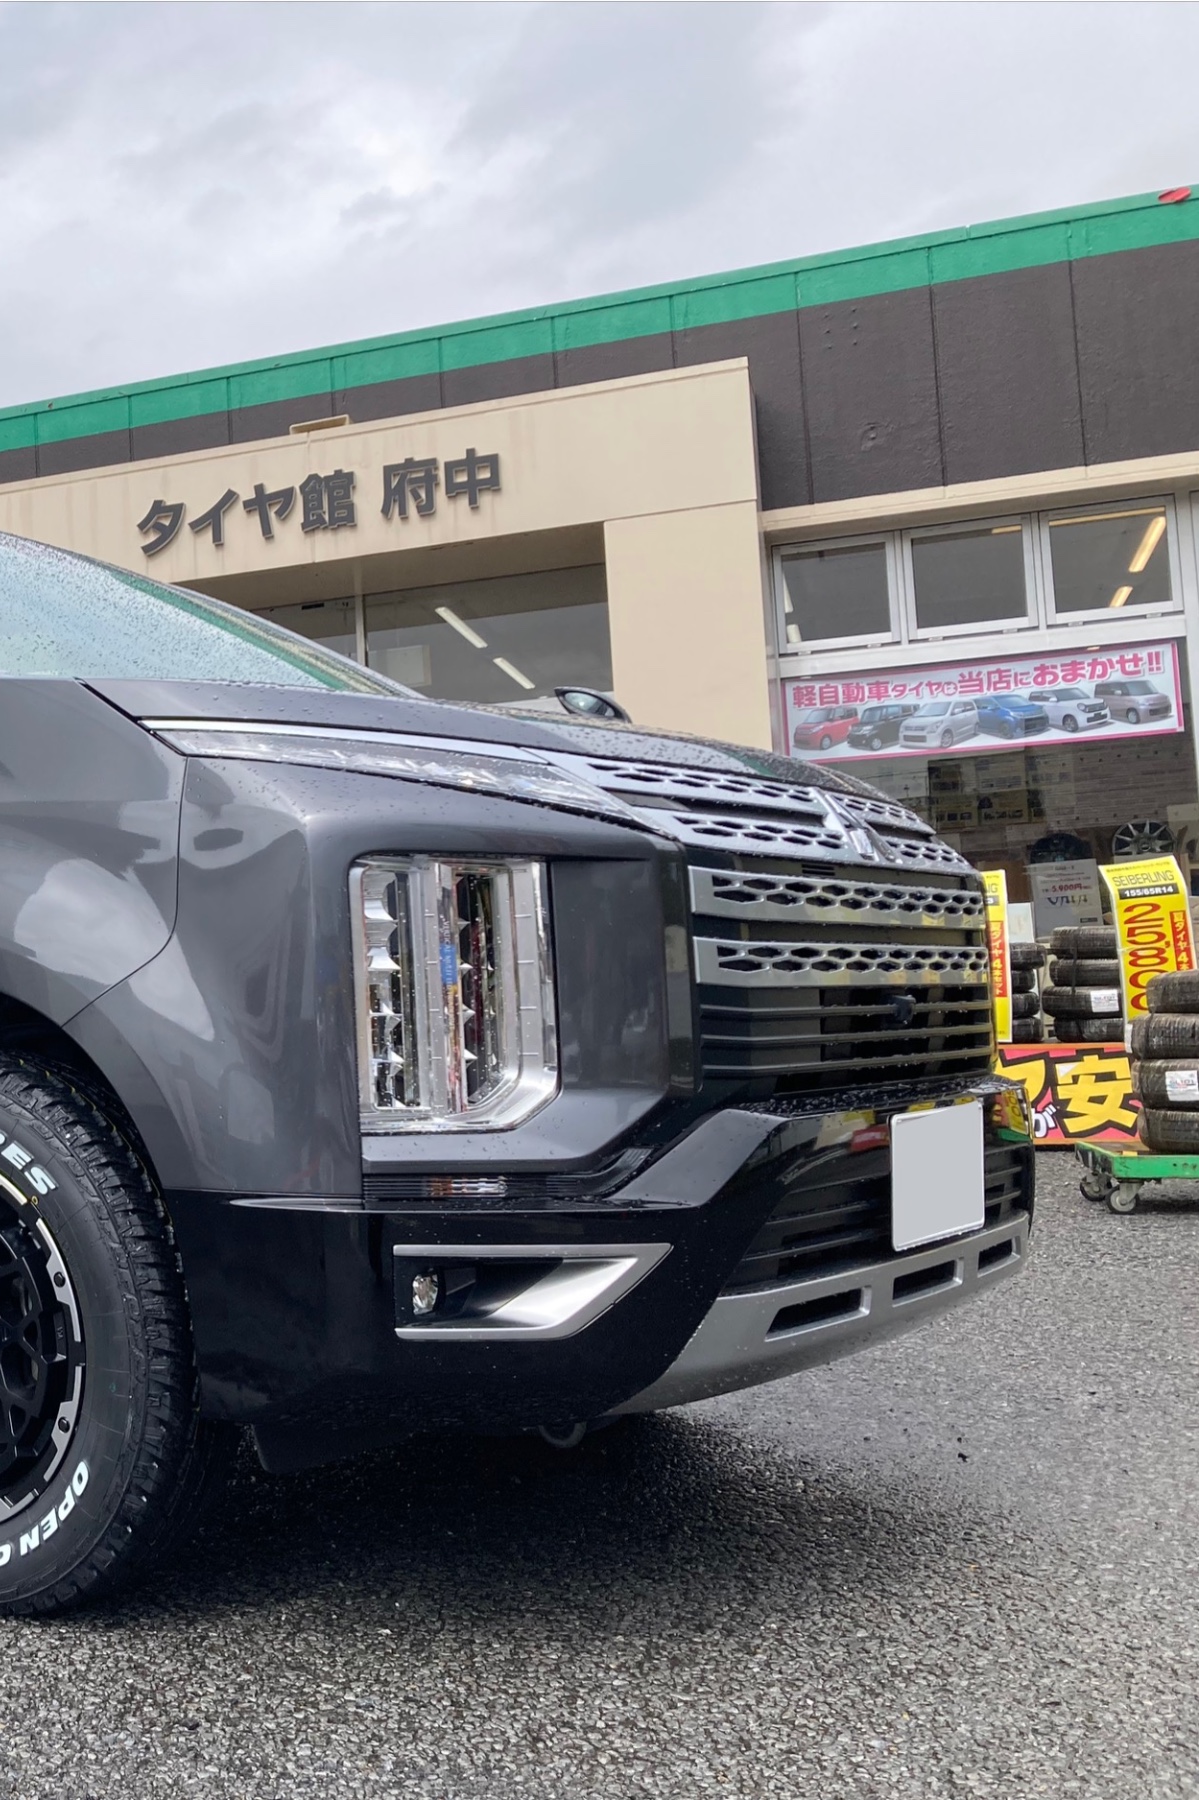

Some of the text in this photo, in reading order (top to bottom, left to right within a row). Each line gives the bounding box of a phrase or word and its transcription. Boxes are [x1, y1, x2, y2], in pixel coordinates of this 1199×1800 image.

[136, 447, 501, 556] タイヤ館 府中
[1111, 869, 1175, 887] SEIBERLING
[1123, 885, 1174, 898] 155/65R14
[19, 1460, 90, 1557] OPEN
